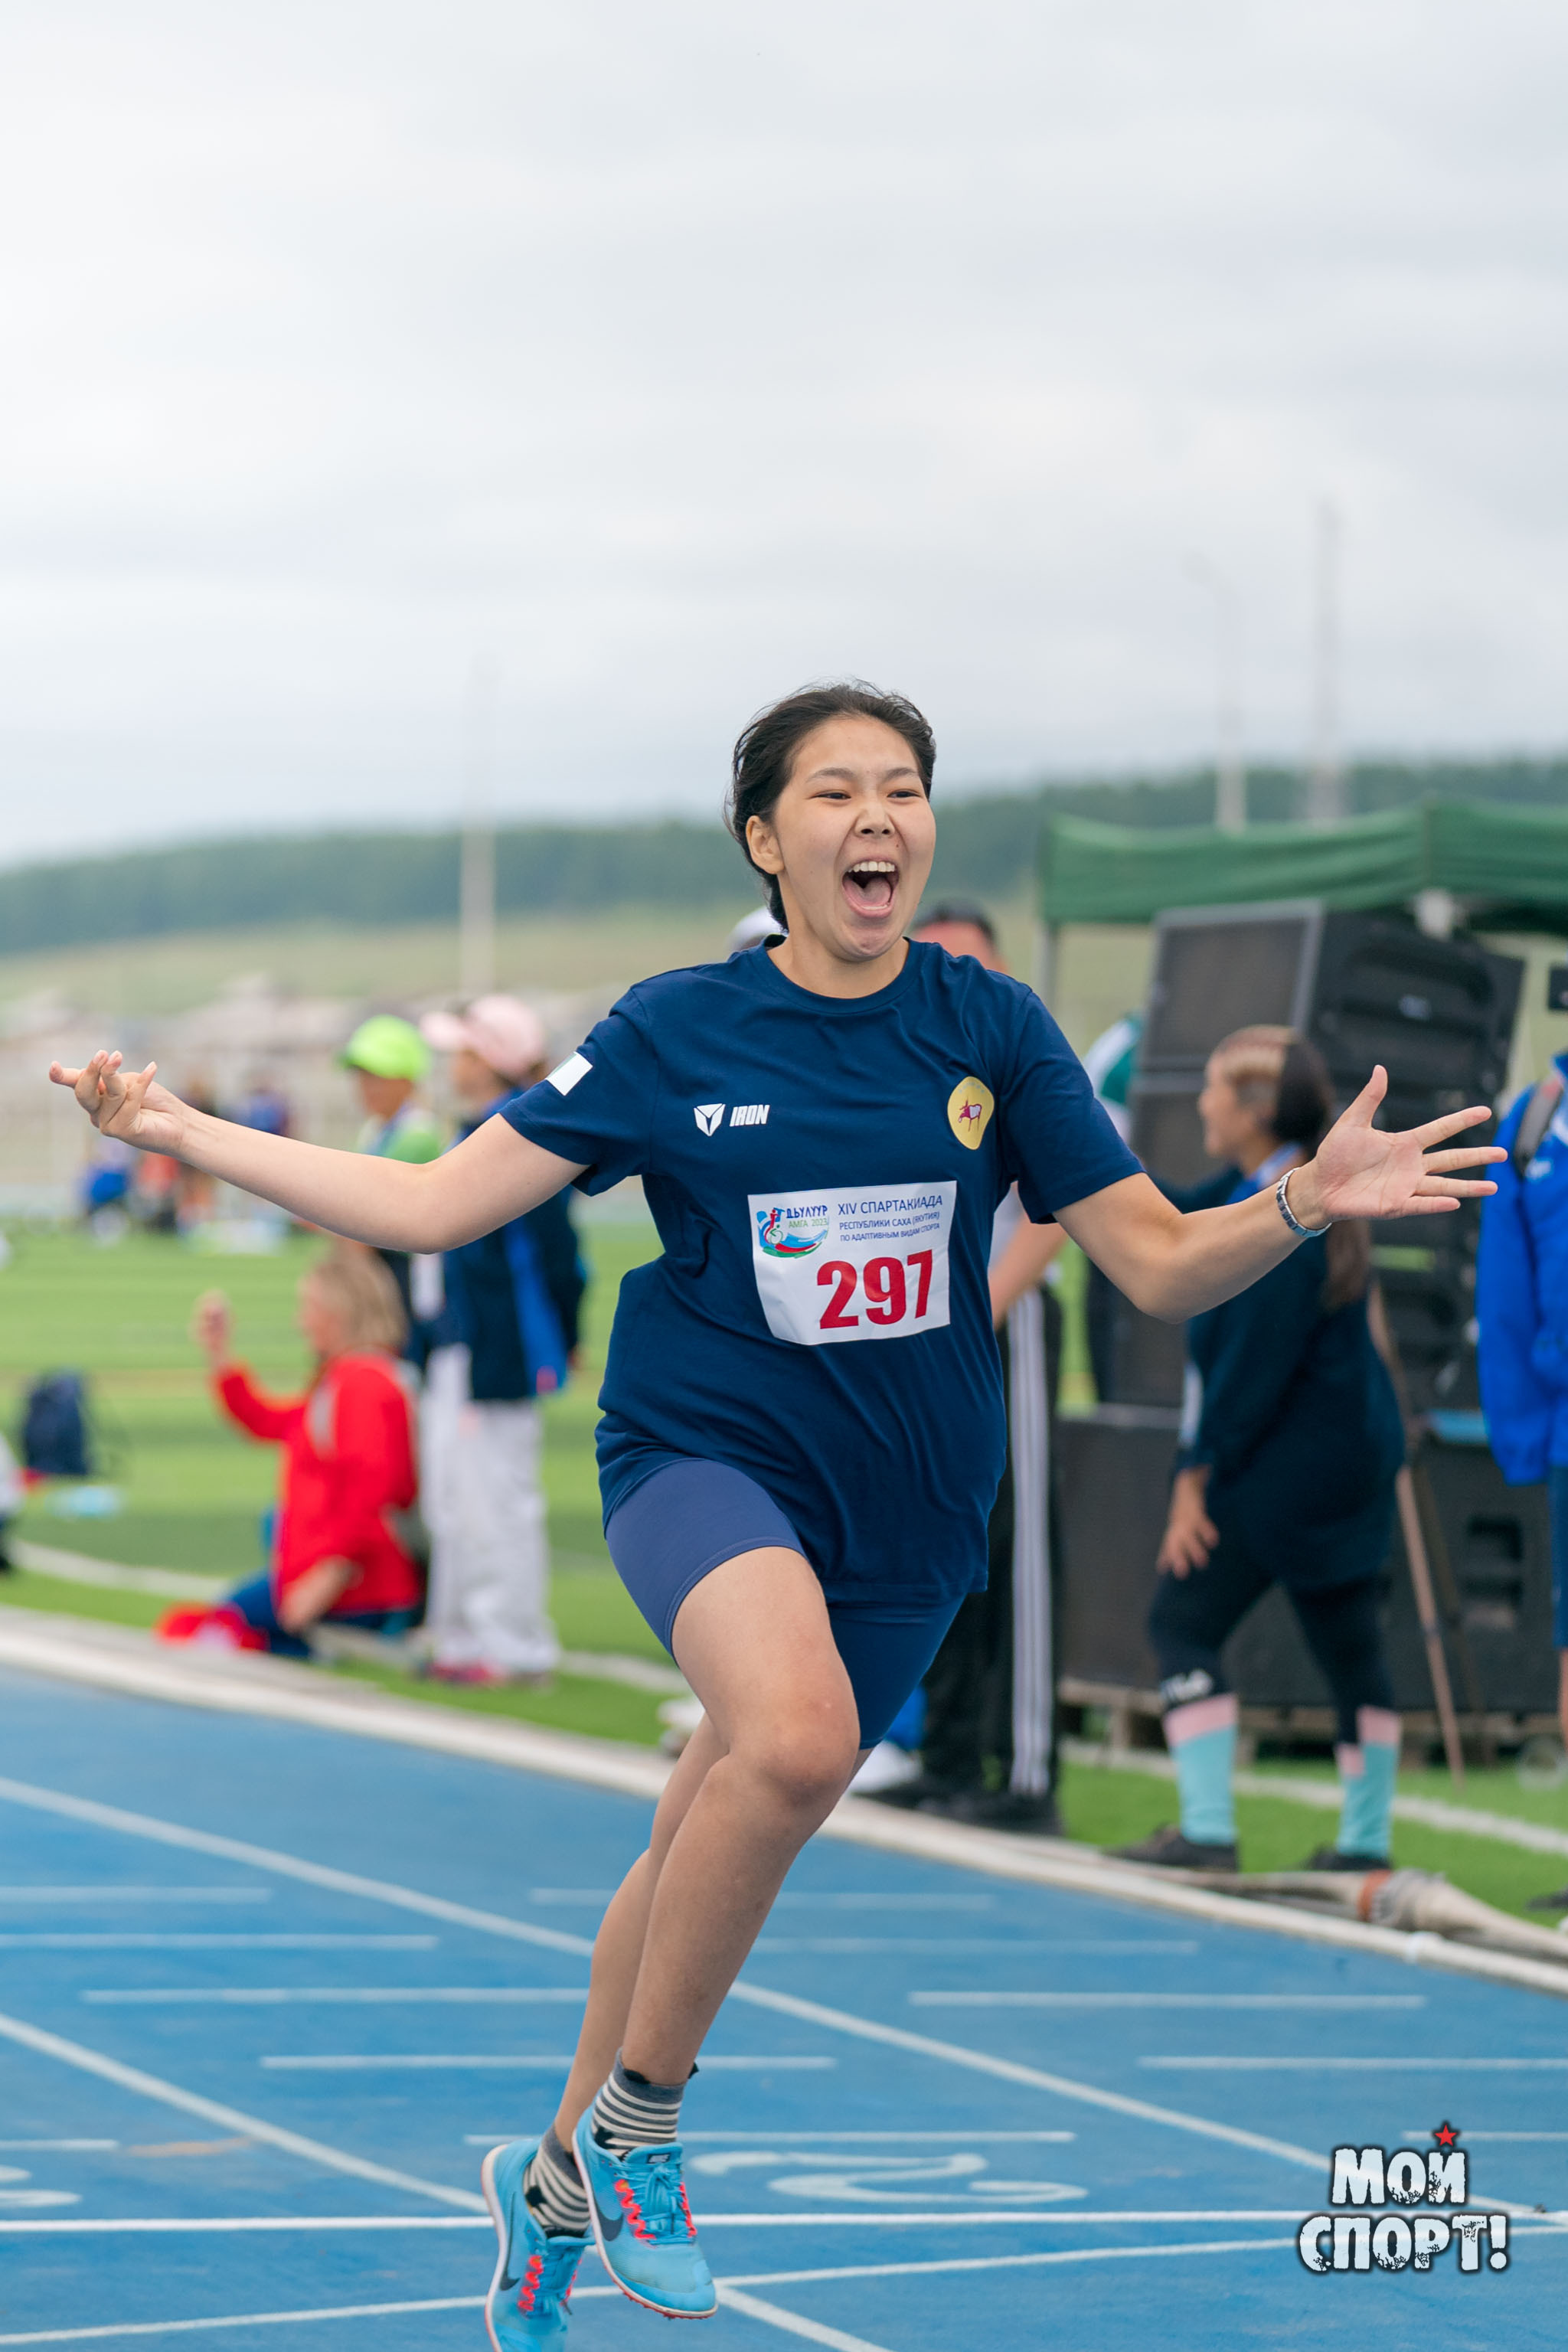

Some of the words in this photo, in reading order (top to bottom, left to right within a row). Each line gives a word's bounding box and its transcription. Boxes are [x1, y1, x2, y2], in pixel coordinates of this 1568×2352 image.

[729, 1103, 770, 1127] IRON
[838, 1202, 858, 1216] XIV
[860, 1194, 943, 1214] СПАРТАКИАДА
[789, 1219, 808, 1228] АМГА
[811, 1217, 828, 1227] 2023
[839, 1219, 890, 1230] РЕСПУБЛИКИ
[891, 1217, 912, 1227] САХА
[912, 1211, 940, 1226] (ЯКУТИЯ)
[840, 1233, 851, 1242] ПО
[851, 1230, 900, 1241] АДАПТИВНЫМ
[900, 1227, 920, 1237] ВИДАМ
[816, 1249, 933, 1330] 297
